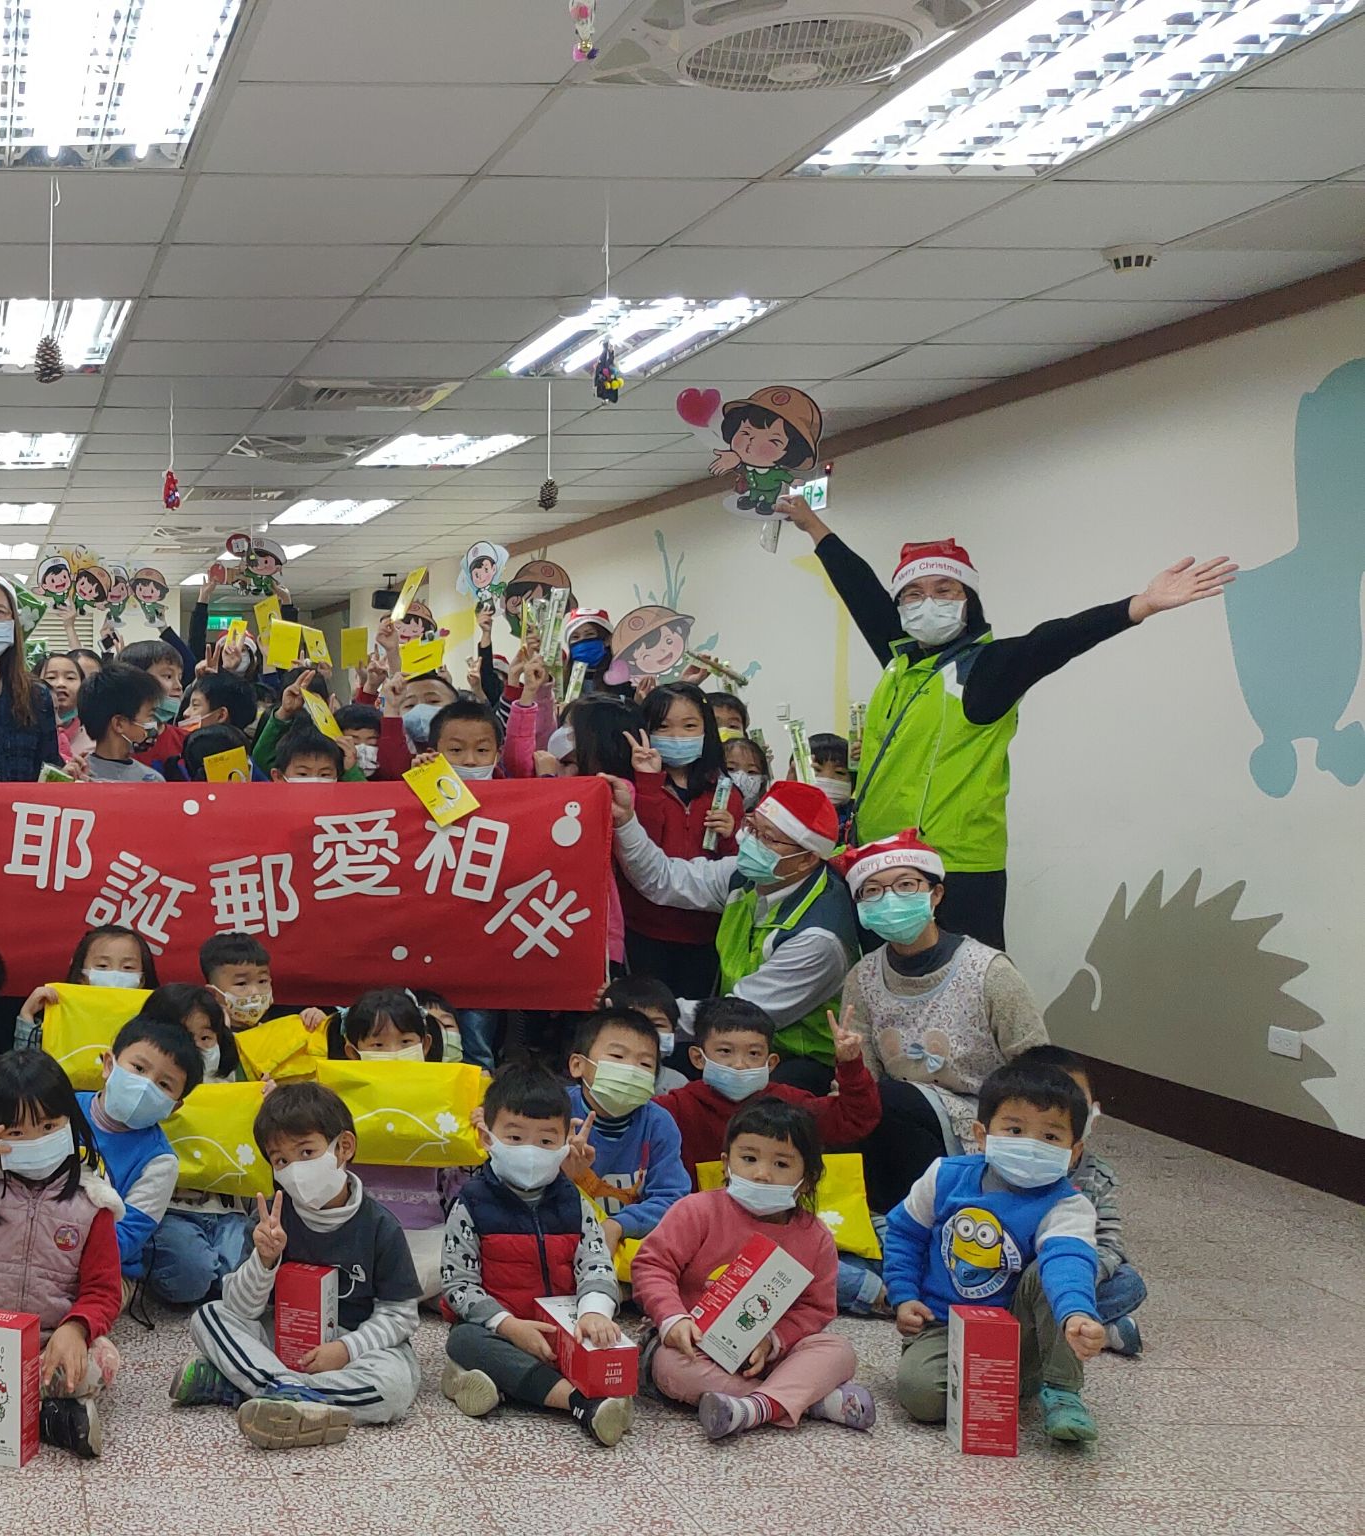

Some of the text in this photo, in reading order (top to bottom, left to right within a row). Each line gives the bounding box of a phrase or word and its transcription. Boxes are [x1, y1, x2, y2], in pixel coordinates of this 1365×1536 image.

[771, 1276, 787, 1290] KITTY
[776, 1270, 793, 1285] HELLO
[605, 1368, 622, 1377] KITTY
[604, 1376, 622, 1385] HELLO
